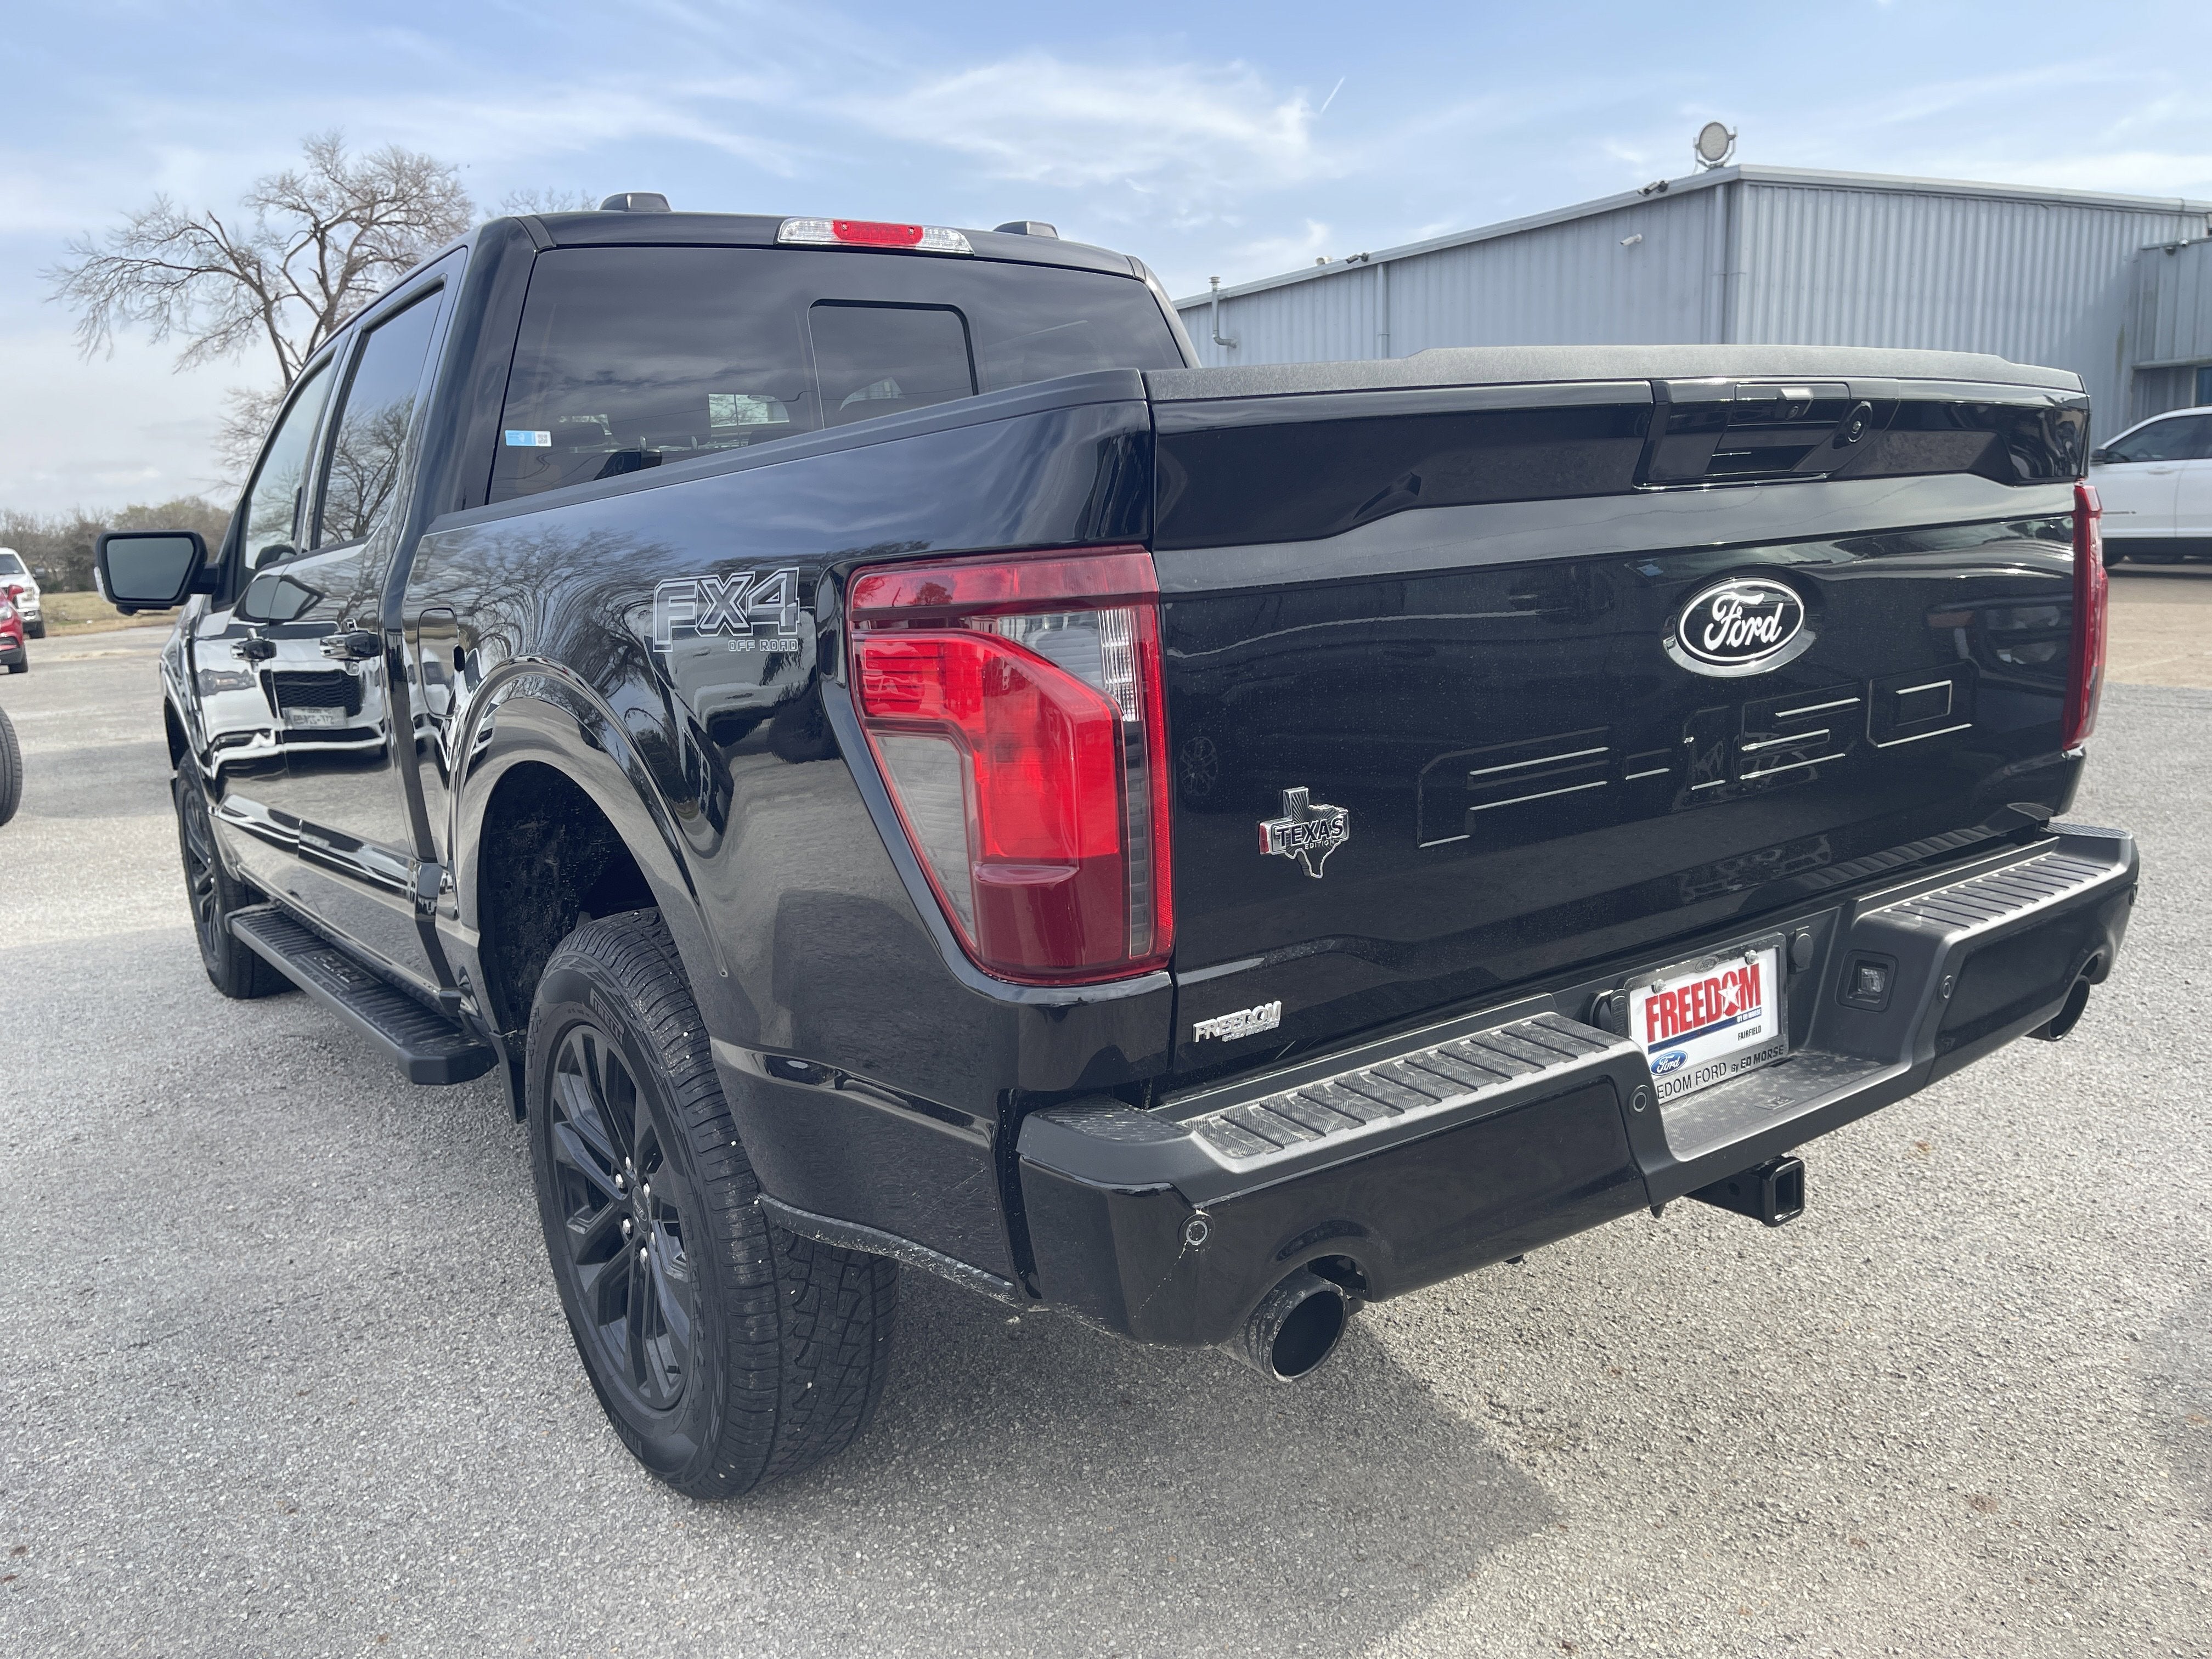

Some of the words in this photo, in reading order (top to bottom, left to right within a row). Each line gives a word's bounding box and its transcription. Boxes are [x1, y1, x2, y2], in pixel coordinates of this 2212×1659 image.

[653, 567, 800, 652] FX4
[1704, 592, 1784, 651] Ford
[728, 639, 755, 652] OFF
[759, 639, 798, 652] ROAD
[1417, 659, 1978, 849] F-150
[1275, 815, 1344, 848] TEXAS
[1305, 839, 1335, 850] EDITION
[589, 988, 625, 1045] PIRELLI
[1193, 1000, 1282, 1043] FREEDOM
[1645, 963, 1761, 1043] FREEDOM
[1748, 1008, 1761, 1019] MORSE
[1737, 1025, 1762, 1041] FAIRFIELD
[1657, 1054, 1681, 1073] Ford
[1695, 1062, 1726, 1086] FORD
[1740, 1056, 1752, 1069] ED
[1753, 1045, 1784, 1064] MORSE
